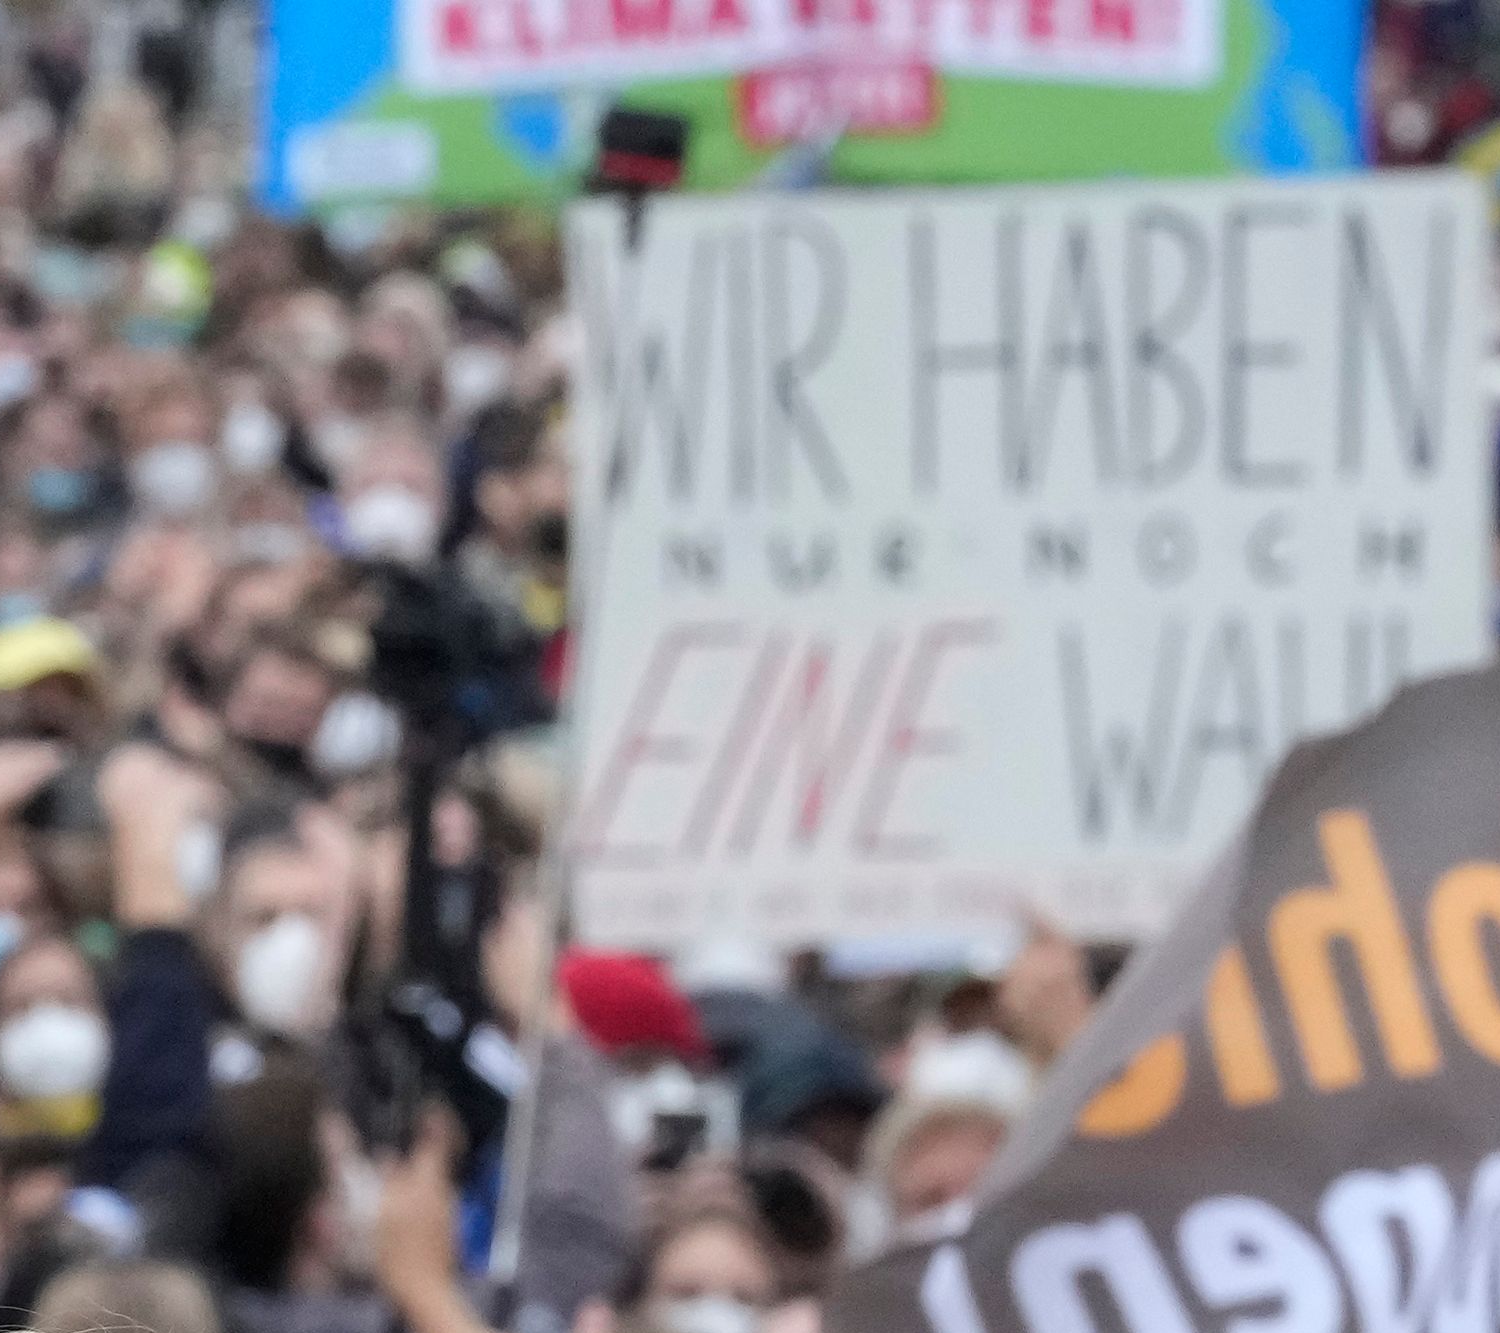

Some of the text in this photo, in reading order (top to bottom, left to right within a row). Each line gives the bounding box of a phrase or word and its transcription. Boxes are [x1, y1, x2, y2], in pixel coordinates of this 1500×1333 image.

[567, 198, 1458, 510] WIR HABEN
[660, 508, 1426, 586] NUR NOCH
[570, 615, 1000, 868] EINE
